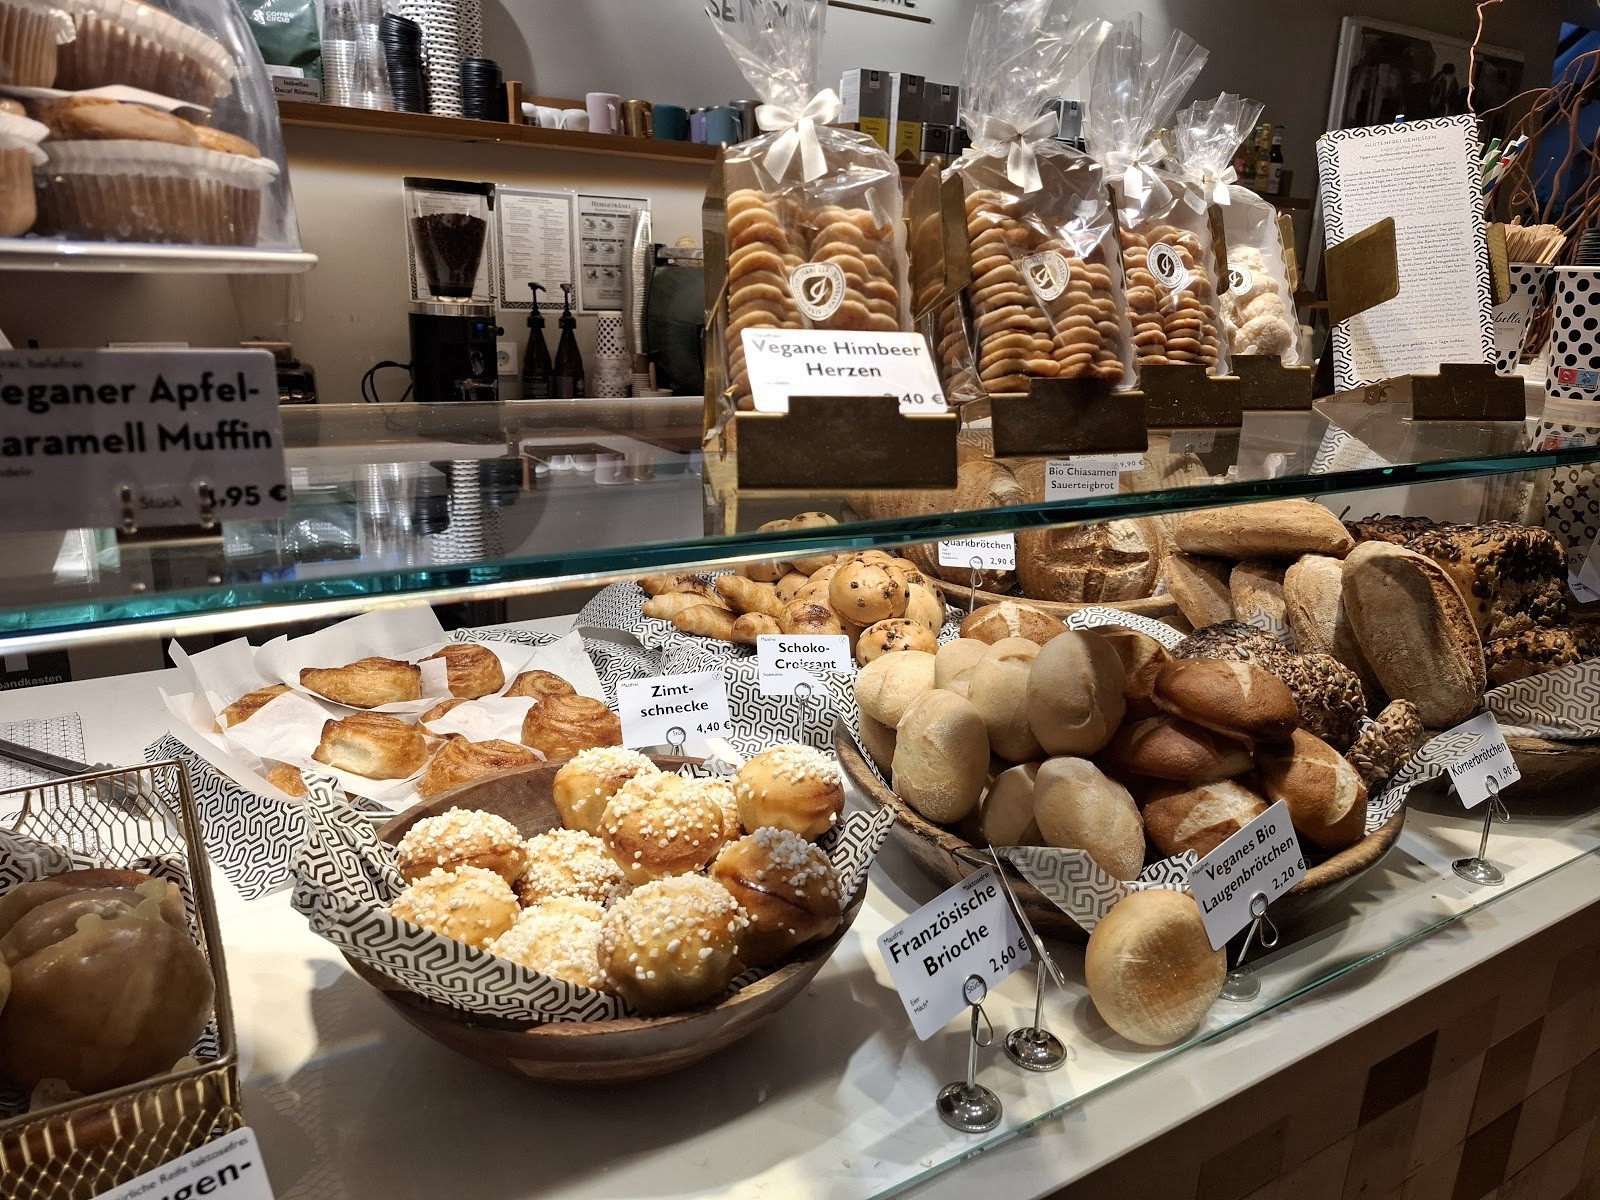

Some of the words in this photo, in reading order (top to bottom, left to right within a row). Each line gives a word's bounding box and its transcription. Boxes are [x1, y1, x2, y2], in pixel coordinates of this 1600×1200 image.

[283, 80, 308, 88] Isabellas
[1364, 138, 1401, 147] GLUTENFREI
[1402, 134, 1436, 142] GENIESSEN
[1492, 311, 1520, 323] bella
[752, 340, 828, 358] Vegane
[834, 341, 922, 357] Himbeer
[806, 362, 882, 377] Herzen
[0, 374, 136, 414] eganer
[150, 371, 260, 411] Apfel-
[931, 394, 944, 405] €
[0, 421, 146, 456] aramell
[158, 419, 272, 452] Muffin
[1049, 468, 1064, 476] Bio
[1067, 468, 1118, 478] Chiasamen
[269, 484, 288, 502] €
[1051, 480, 1114, 492] Sauerteigbrot
[140, 496, 182, 510] Stück
[942, 539, 1012, 550] Quarkbrötchen
[990, 558, 1007, 566] 2,90
[778, 642, 830, 653] Schoko-
[775, 659, 837, 669] Croissant
[651, 684, 694, 698] Zimt-
[640, 700, 709, 717] schnecke
[696, 722, 720, 734] 4,40
[723, 720, 731, 729] €
[1450, 742, 1507, 777] Körnerbrötchen
[1498, 765, 1512, 780] 1,90
[1513, 762, 1519, 772] €
[1205, 840, 1255, 881] Veganes
[1255, 824, 1276, 844] Bio
[1202, 836, 1294, 914] Laugenbrötchen
[1272, 866, 1295, 890] 2,20
[1297, 858, 1305, 870] €
[889, 885, 997, 964] Französische
[883, 928, 904, 945] Maisfrei
[922, 924, 989, 977] Brioche
[989, 945, 1016, 973] 2,60
[1018, 937, 1028, 951] €
[161, 1161, 252, 1200] gen-
